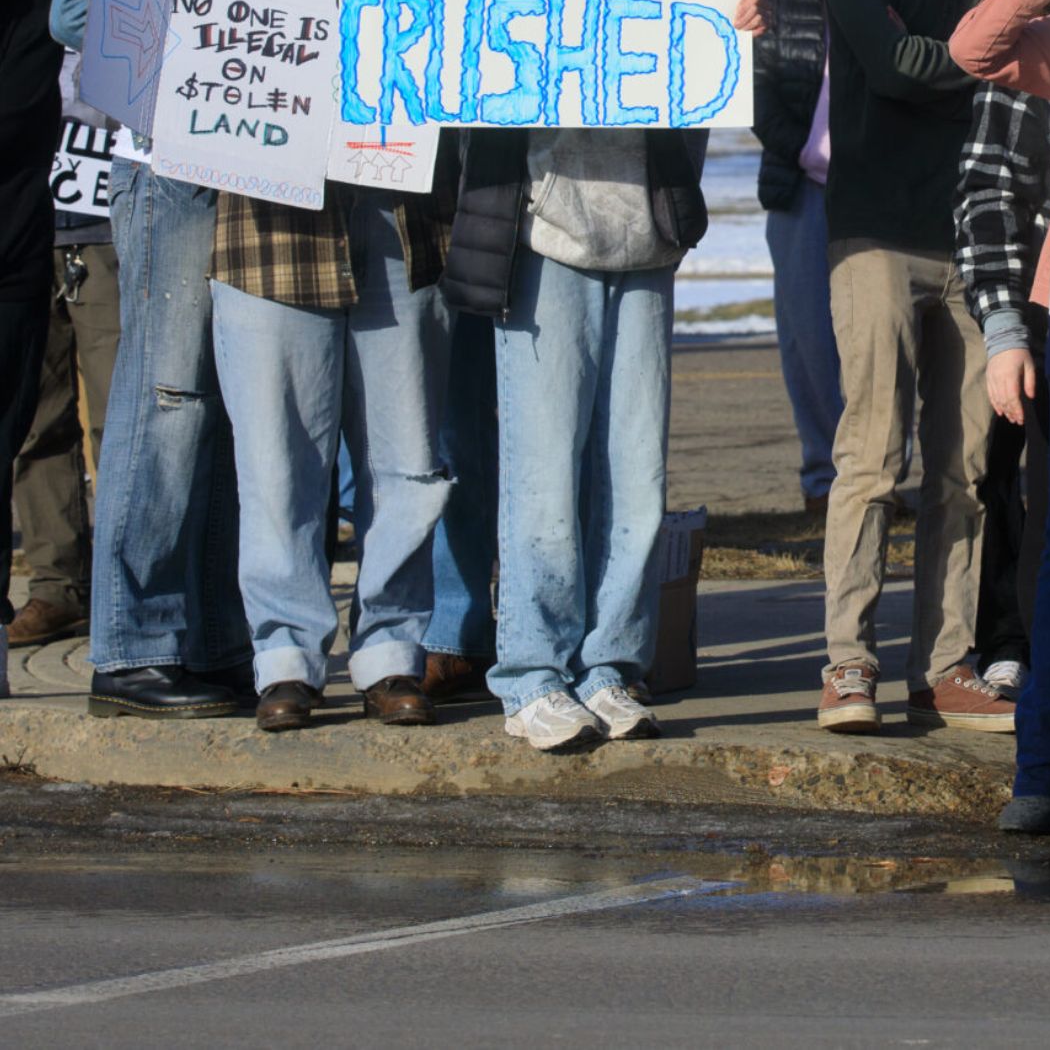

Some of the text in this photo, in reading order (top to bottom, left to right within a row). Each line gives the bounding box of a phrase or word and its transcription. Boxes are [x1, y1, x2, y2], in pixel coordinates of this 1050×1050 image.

[227, 0, 288, 29] ONE
[294, 16, 330, 41] IS
[193, 22, 320, 66] ILLEGAL
[221, 57, 266, 85] ON
[188, 109, 289, 147] LAND
[50, 170, 110, 207] CE
